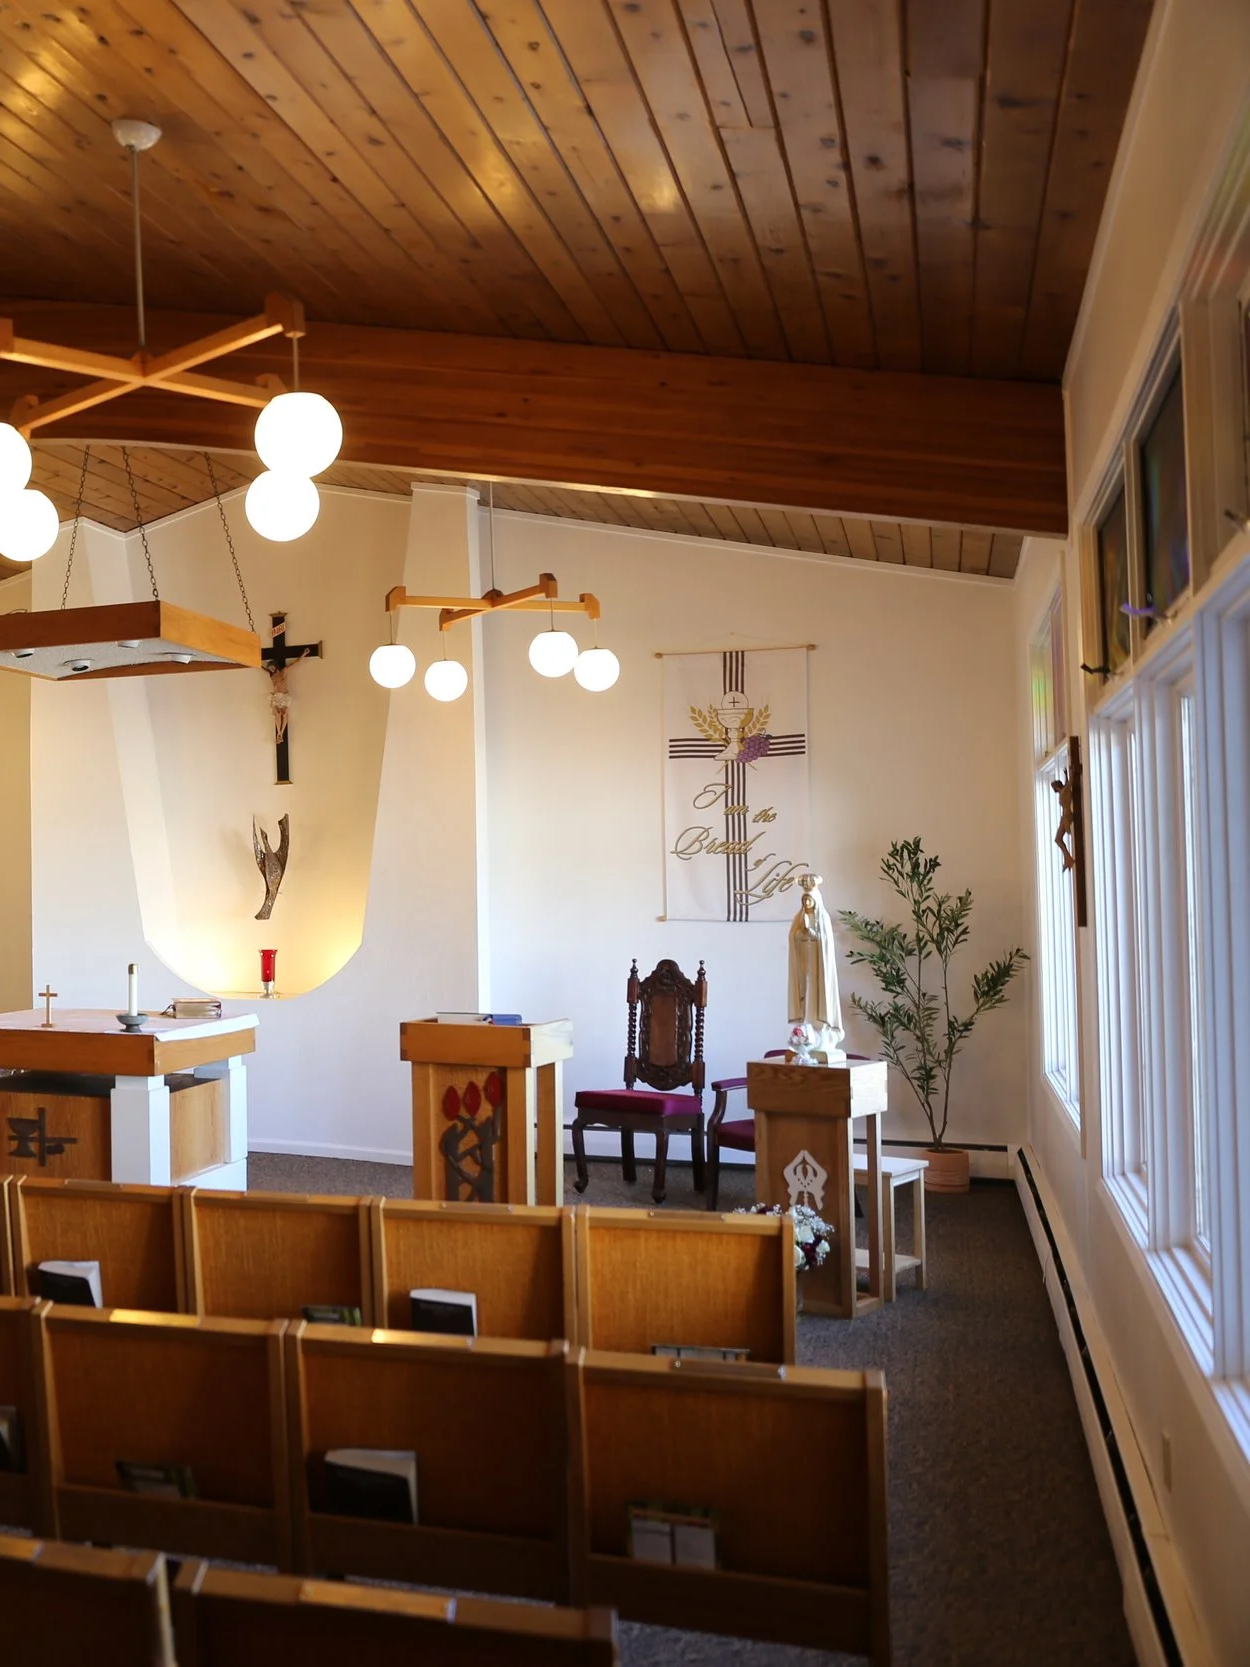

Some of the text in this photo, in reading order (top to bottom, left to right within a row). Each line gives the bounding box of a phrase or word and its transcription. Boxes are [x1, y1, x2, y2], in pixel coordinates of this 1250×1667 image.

[724, 804, 778, 823] am the
[670, 826, 766, 861] Bread
[734, 860, 810, 906] Life
